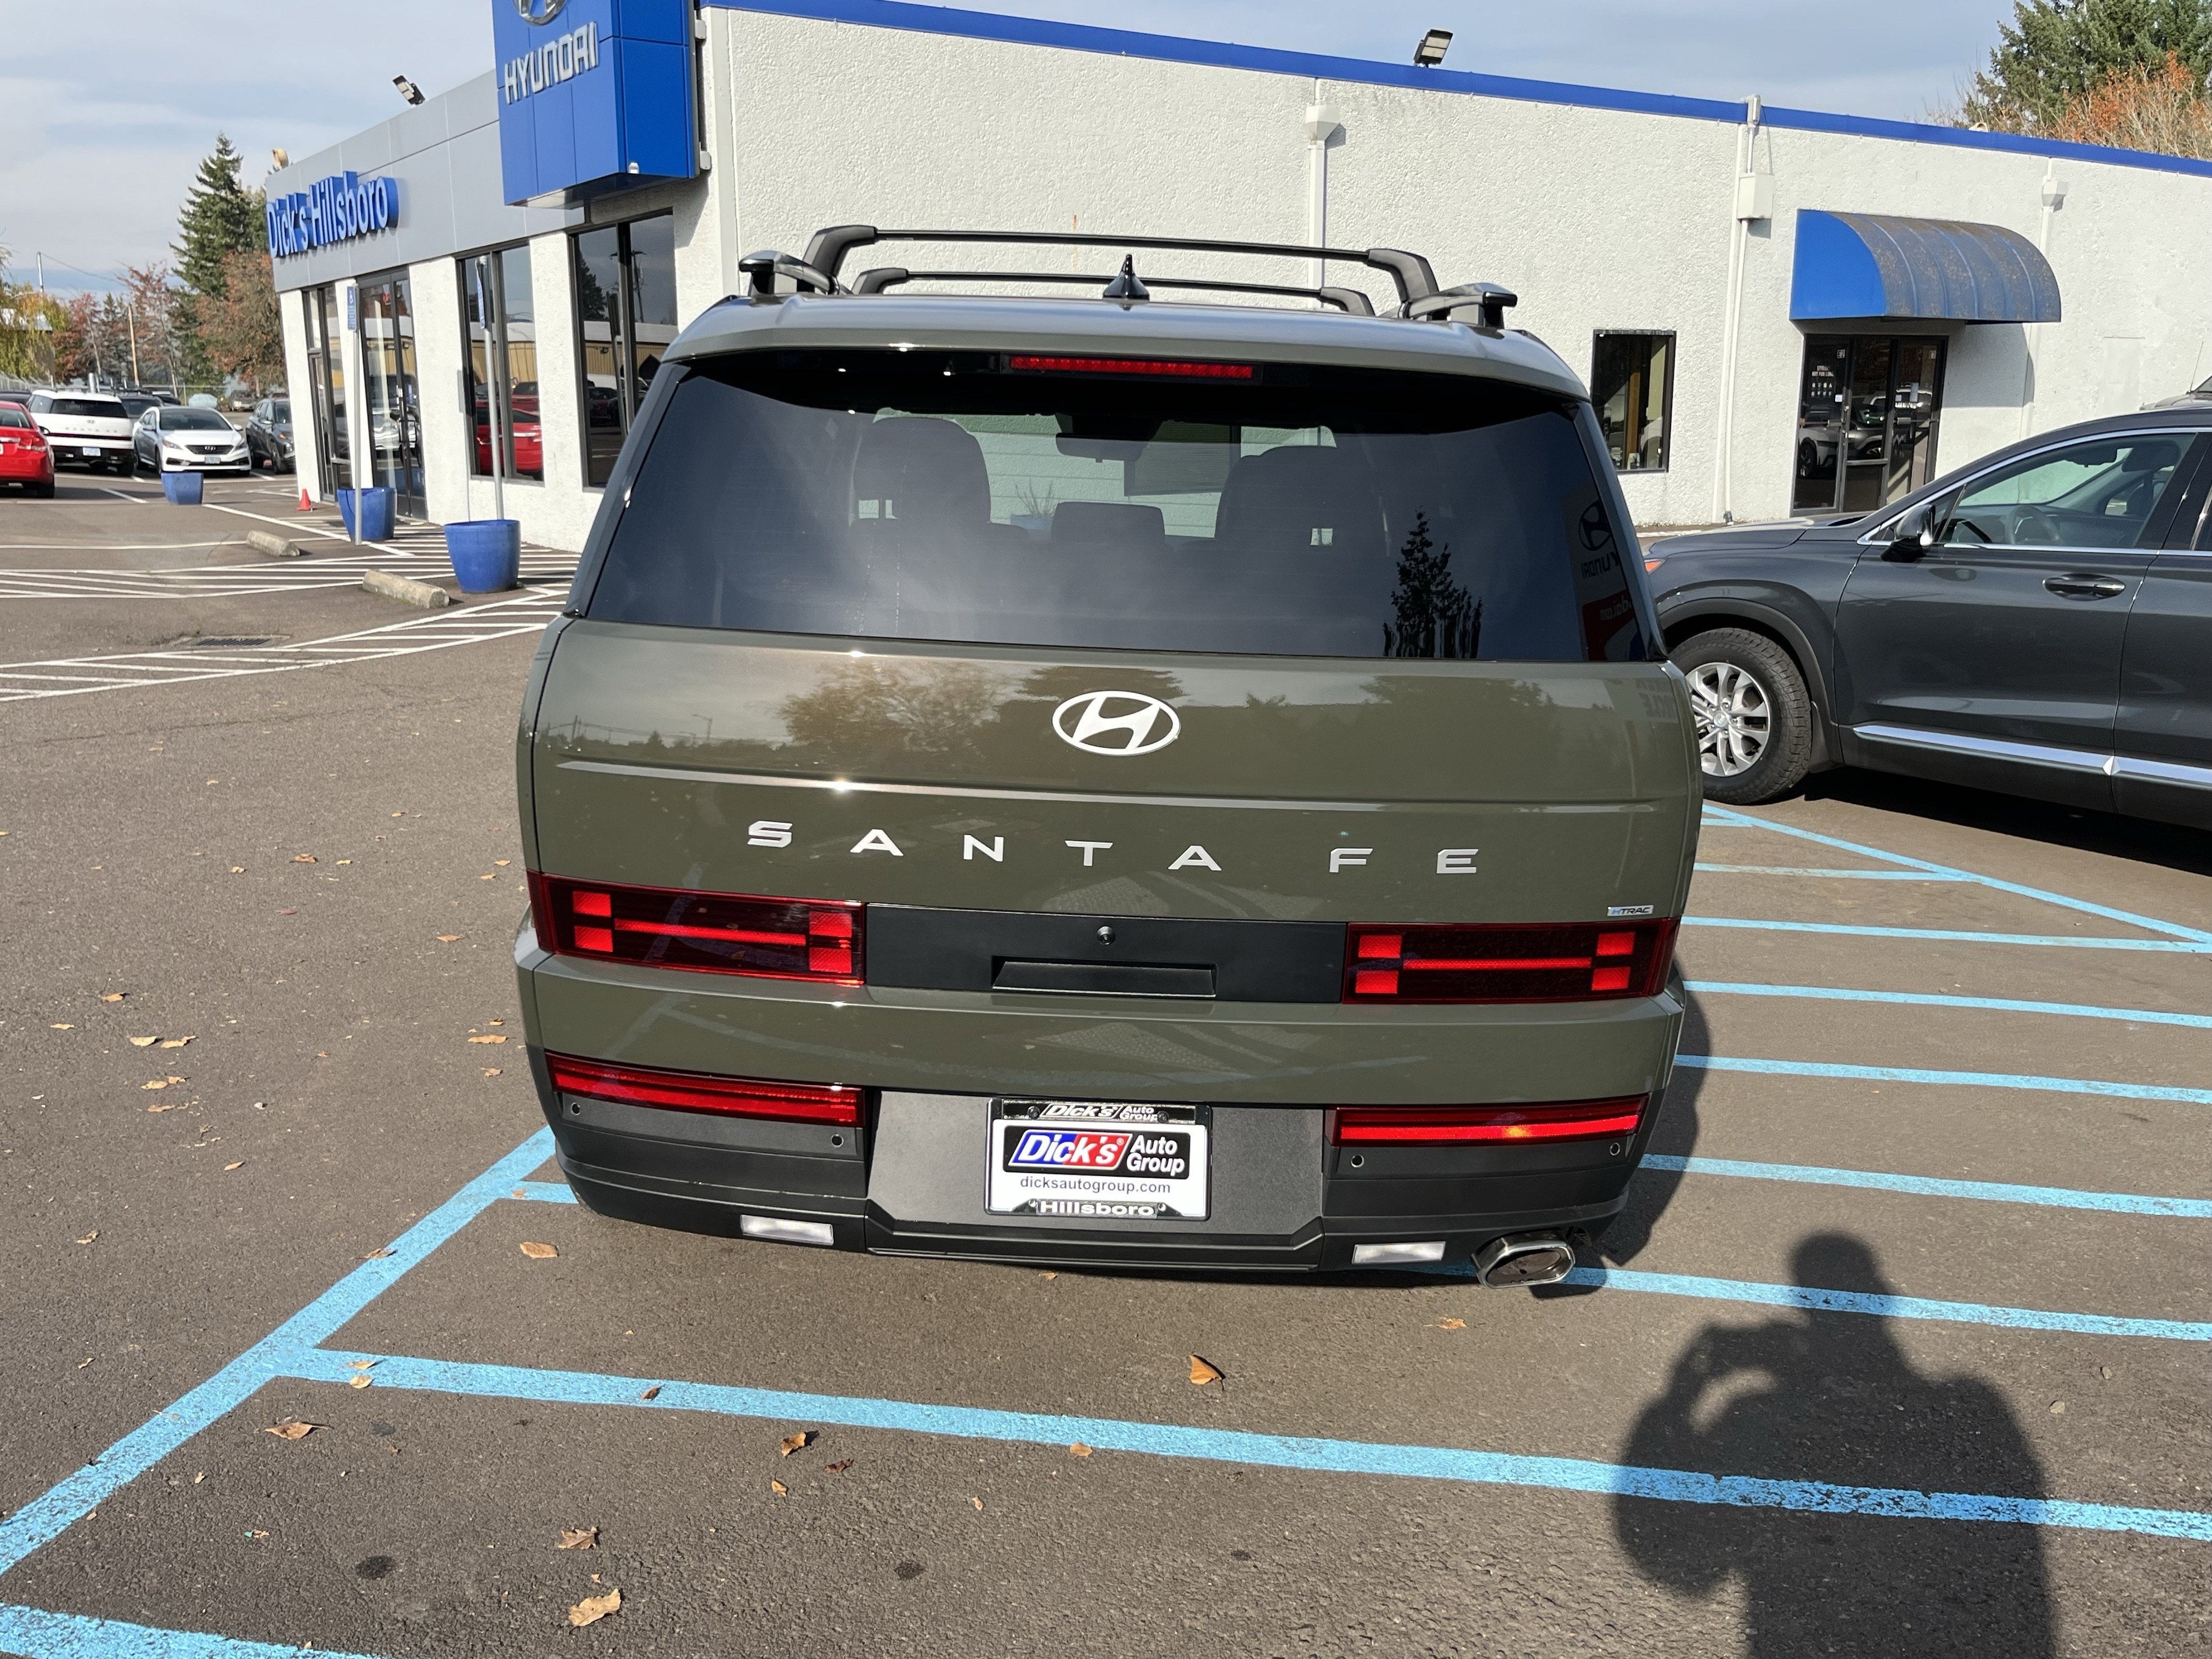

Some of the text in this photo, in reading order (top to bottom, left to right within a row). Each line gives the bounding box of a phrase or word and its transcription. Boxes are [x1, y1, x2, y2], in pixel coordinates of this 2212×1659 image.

[505, 21, 598, 105] HYUNDAI
[267, 171, 396, 258] Dick's Hillsboro
[747, 820, 1479, 874] SANTA FE
[1119, 1112, 1158, 1121] Group
[1124, 1105, 1154, 1114] Auto
[1130, 1135, 1178, 1155] Auto
[1126, 1153, 1185, 1176] Group
[1020, 1176, 1171, 1194] dicksautogroup.com
[1040, 1201, 1154, 1216] Hillsboro
